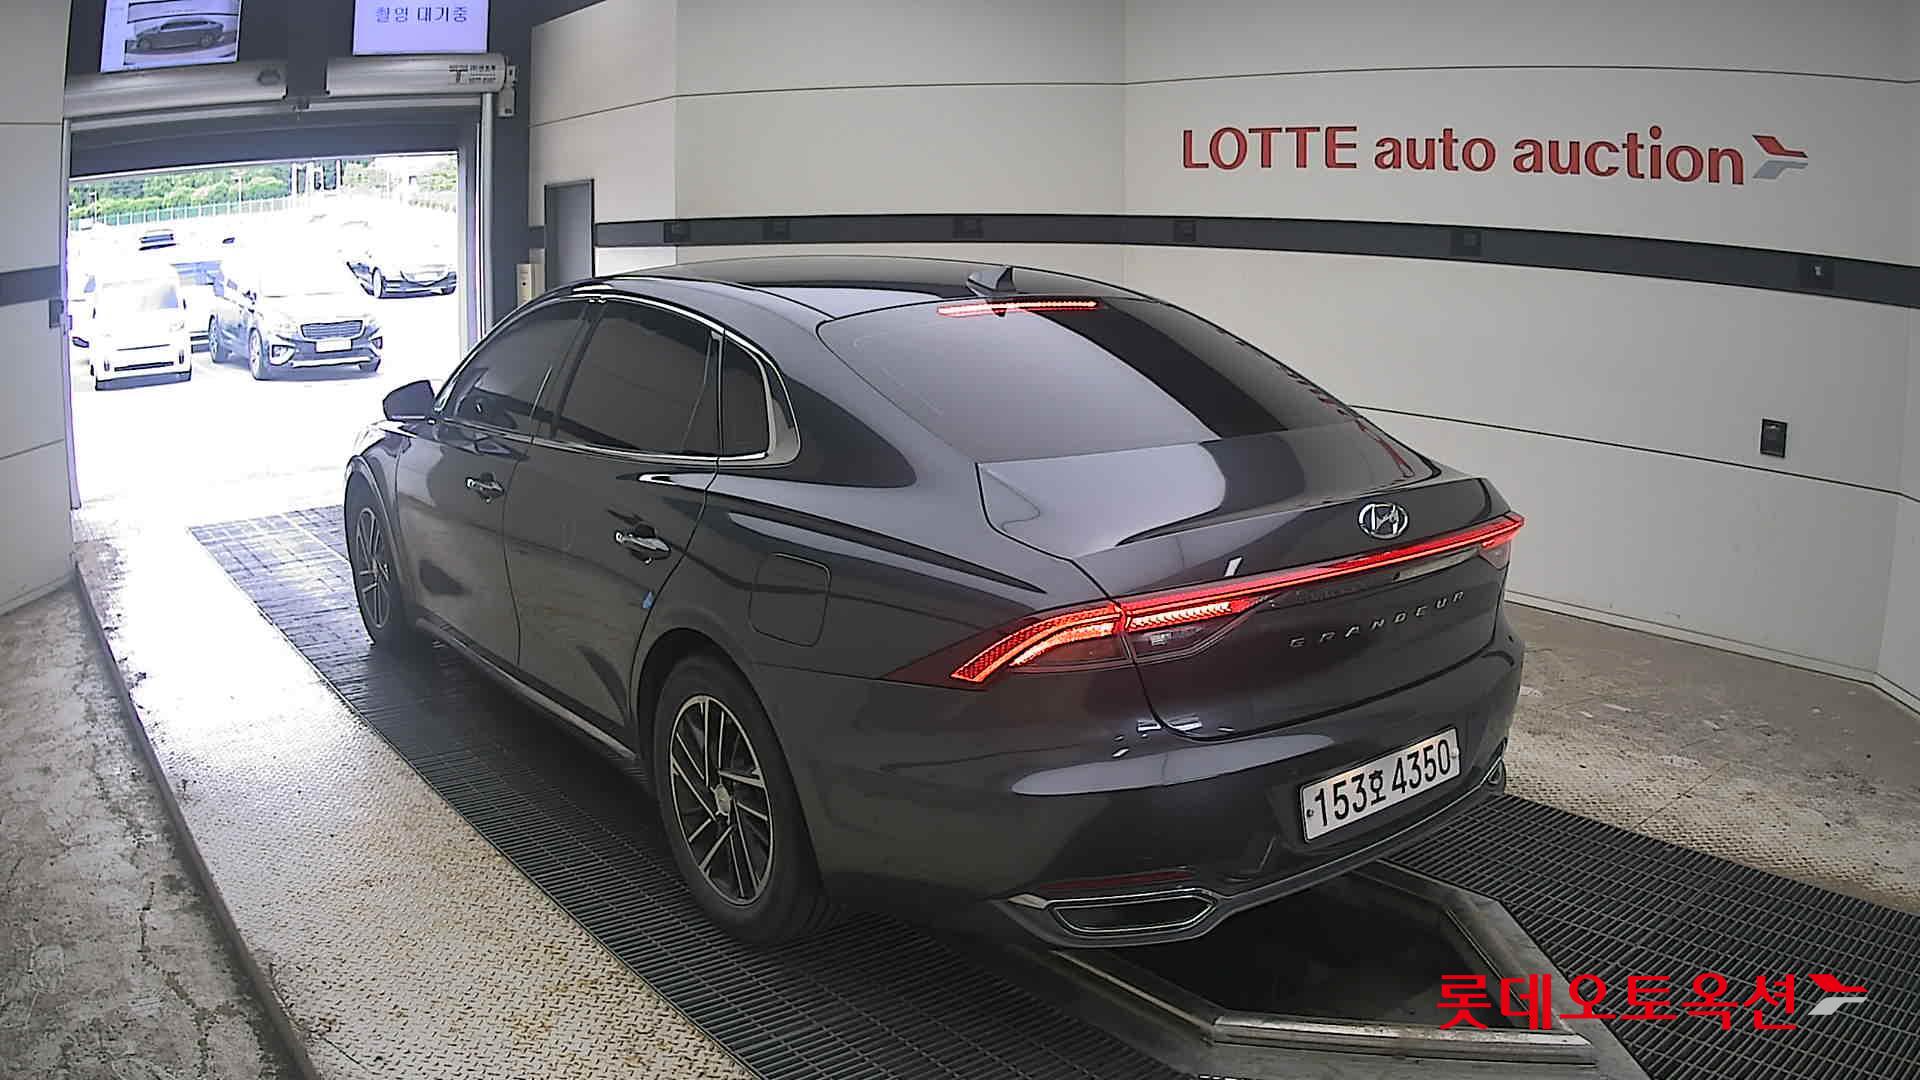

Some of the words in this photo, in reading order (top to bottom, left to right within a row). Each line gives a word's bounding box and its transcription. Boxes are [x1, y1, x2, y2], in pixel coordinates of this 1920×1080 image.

[417, 6, 467, 23] 대기중
[1183, 126, 1357, 169] LOTTE
[1374, 128, 1496, 172] auto
[1512, 125, 1744, 185] auction
[1289, 591, 1464, 648] GRANDEUR
[1315, 769, 1386, 826] 153호
[1392, 739, 1450, 794] 4350
